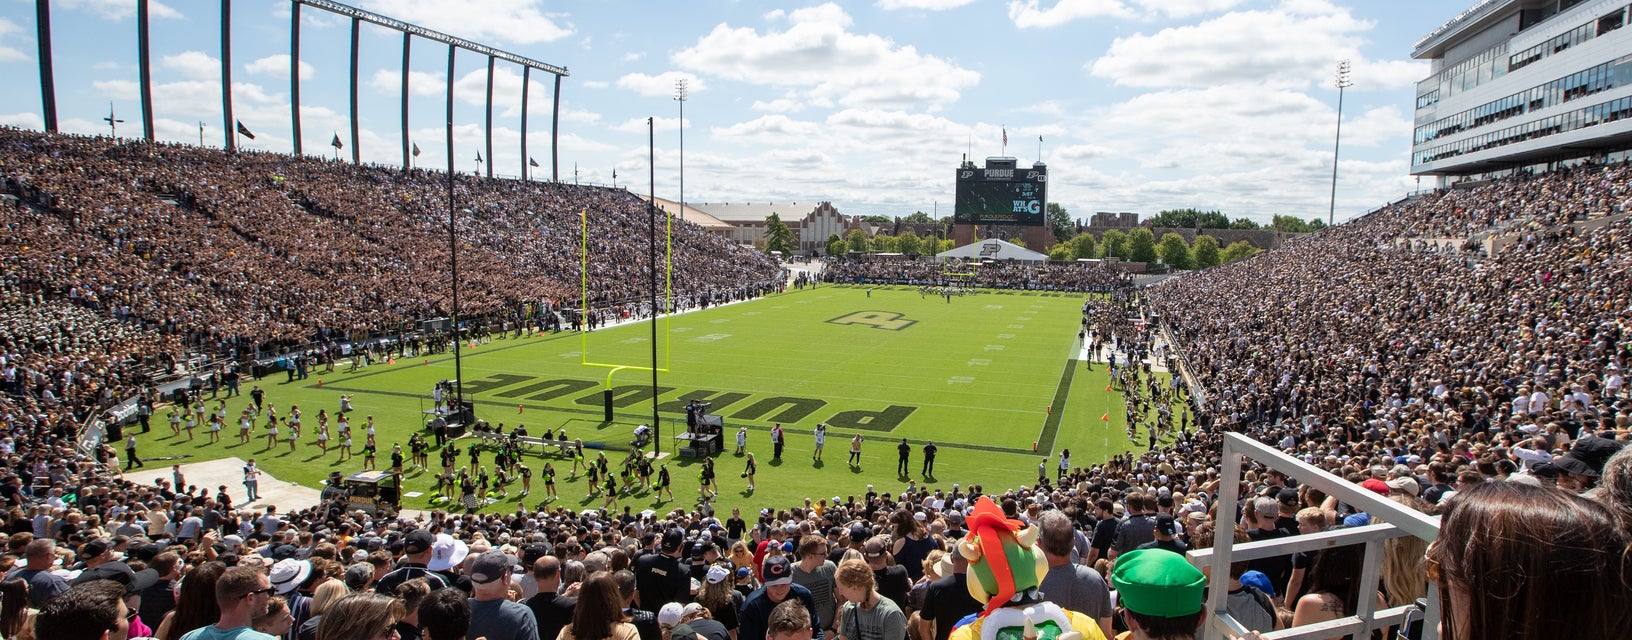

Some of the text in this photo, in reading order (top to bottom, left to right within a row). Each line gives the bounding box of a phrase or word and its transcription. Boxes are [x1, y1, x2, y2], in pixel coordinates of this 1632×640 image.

[984, 169, 1014, 177] PURDUE
[1028, 200, 1040, 214] G
[453, 374, 917, 433] PURDUE
[770, 564, 783, 574] C
